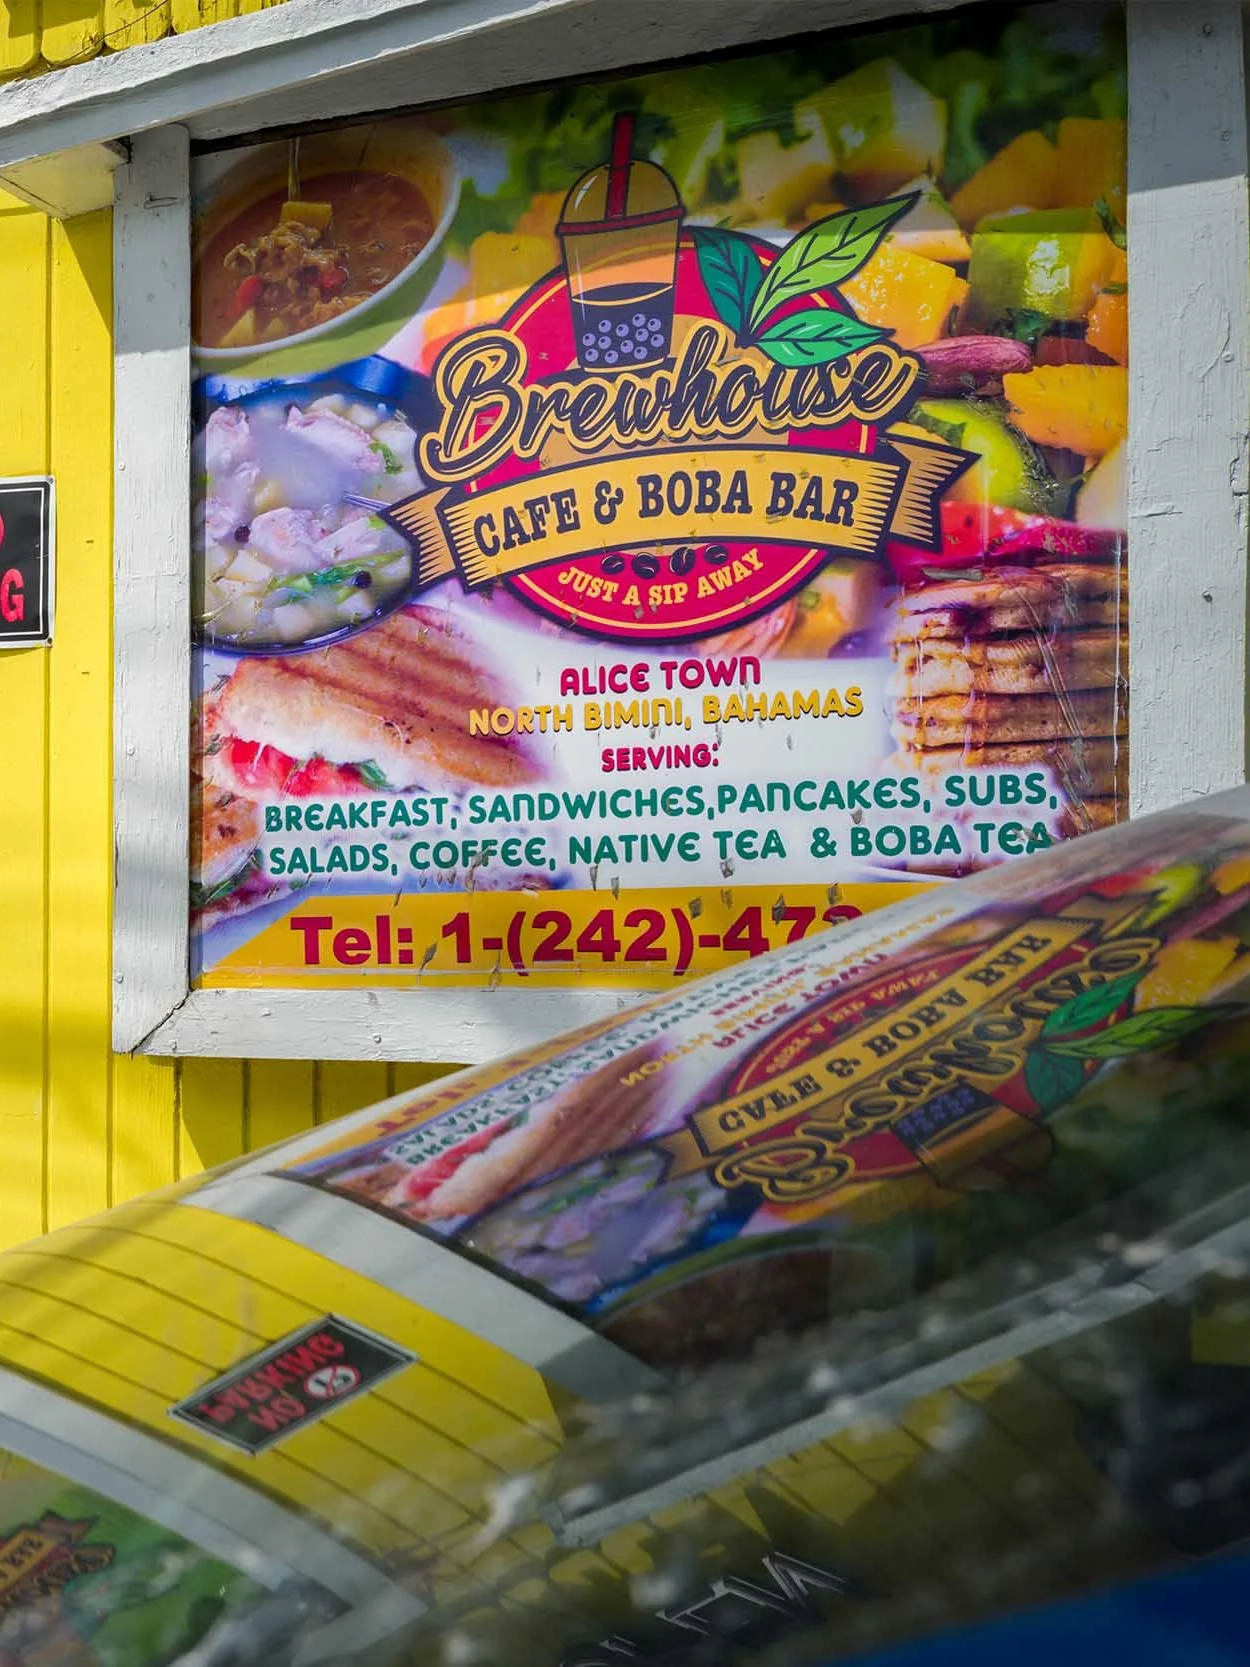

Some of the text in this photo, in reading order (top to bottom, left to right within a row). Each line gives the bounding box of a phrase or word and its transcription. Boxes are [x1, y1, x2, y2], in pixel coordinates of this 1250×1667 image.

[422, 322, 918, 480] Brewhouse
[474, 470, 859, 556] CAFE & BOBA BAR
[558, 548, 765, 606] JUST A SIP AWAY
[559, 655, 762, 697] ALICE TOWN
[469, 686, 864, 737] NORTH BIMINI, BAHAMAS
[601, 742, 720, 774] SERVING:
[265, 796, 457, 833] BREAKFAST,
[945, 771, 1058, 811] SUBS,
[270, 821, 1053, 876] SALADS, COFFEE, NATIVE TEA & BOBA TEA
[290, 915, 414, 966] Tel:
